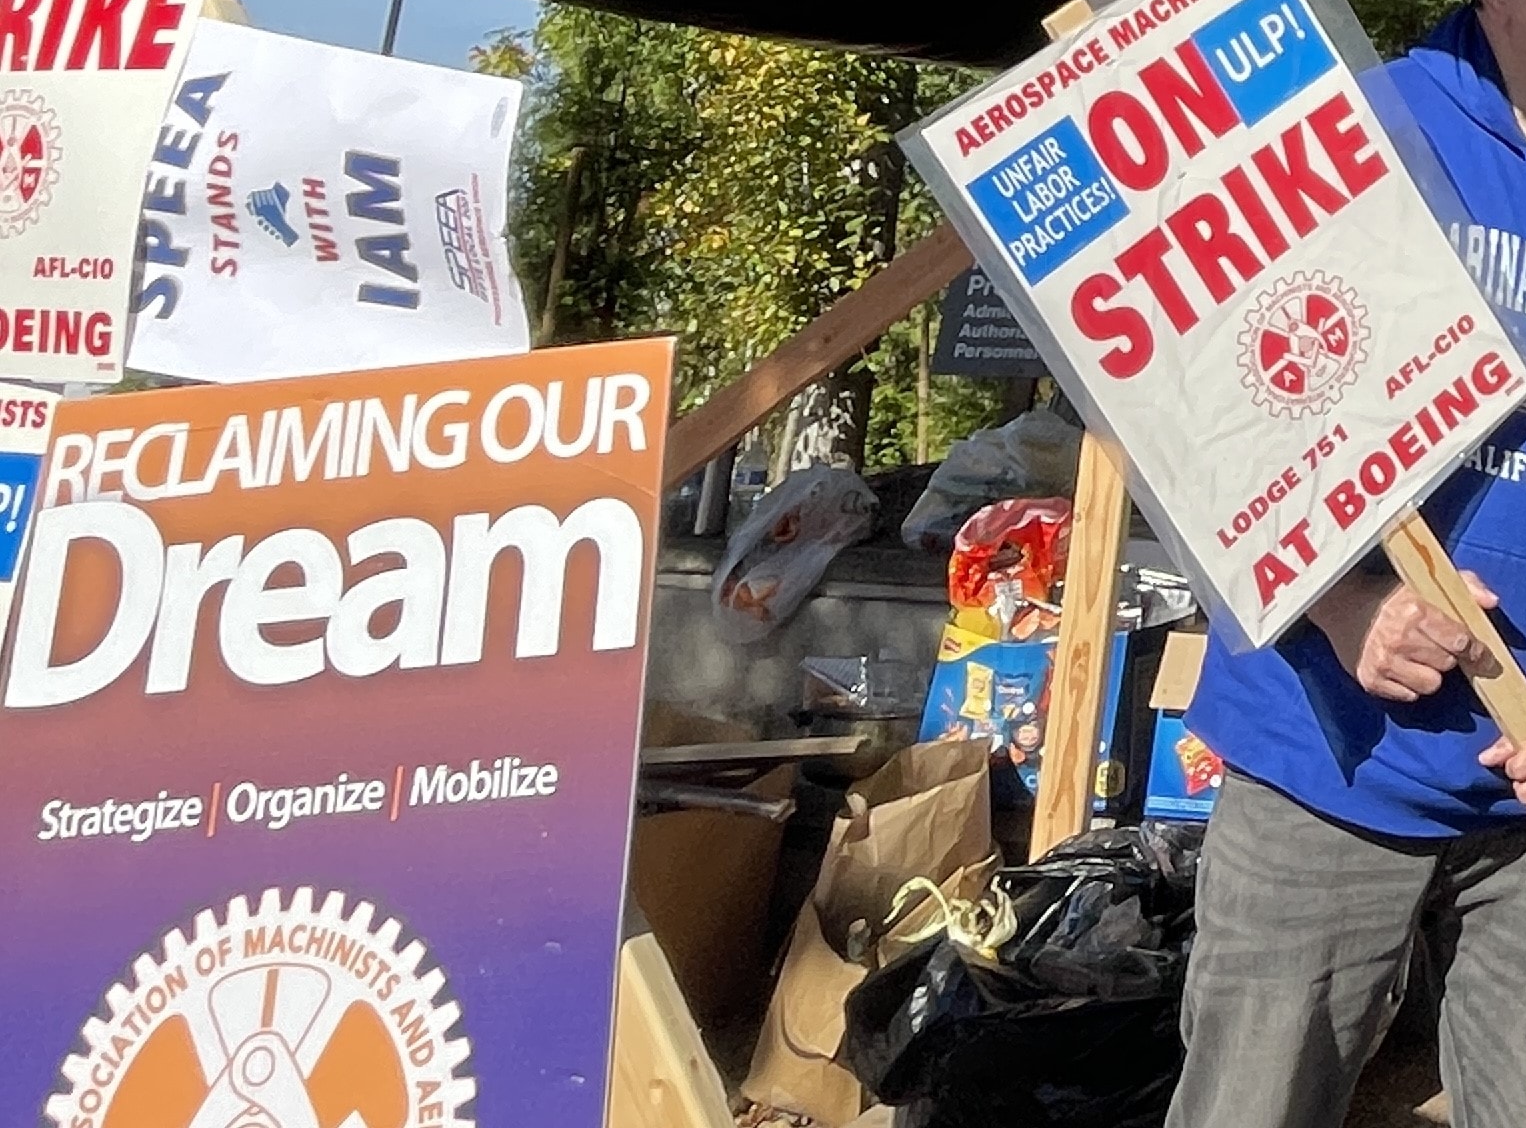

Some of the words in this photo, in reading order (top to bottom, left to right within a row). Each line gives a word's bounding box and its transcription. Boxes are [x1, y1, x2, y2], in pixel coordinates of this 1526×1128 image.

[954, 37, 1110, 157] AEROSPACE
[1216, 4, 1305, 84] ULP!
[991, 137, 1067, 198] UNFAIR
[1088, 37, 1242, 191] ON
[129, 71, 232, 319] SPEEA
[206, 131, 240, 277] STANDS
[302, 178, 340, 262] WITH
[344, 149, 422, 310] IAM
[435, 189, 472, 293] SPEEA
[1009, 177, 1117, 267] PRACTICES!
[1013, 166, 1082, 222] LABOR
[1071, 91, 1389, 379] STRIKE
[33, 257, 114, 279] AFL-CIO
[43, 389, 470, 507] RECLAIMING
[480, 373, 650, 464] OUR
[1217, 467, 1301, 549] LODGE
[1302, 424, 1349, 471] 751
[1384, 314, 1475, 399] AFL-CIO
[1253, 518, 1318, 609] AT
[1324, 351, 1512, 530] BOEING
[5, 498, 644, 708] Dream
[37, 790, 203, 842] Strategize
[226, 773, 386, 830] Organize
[409, 757, 559, 807] Mobilize
[195, 937, 231, 976] OF
[244, 924, 401, 1001] MACHINISTS
[390, 998, 435, 1067] AND
